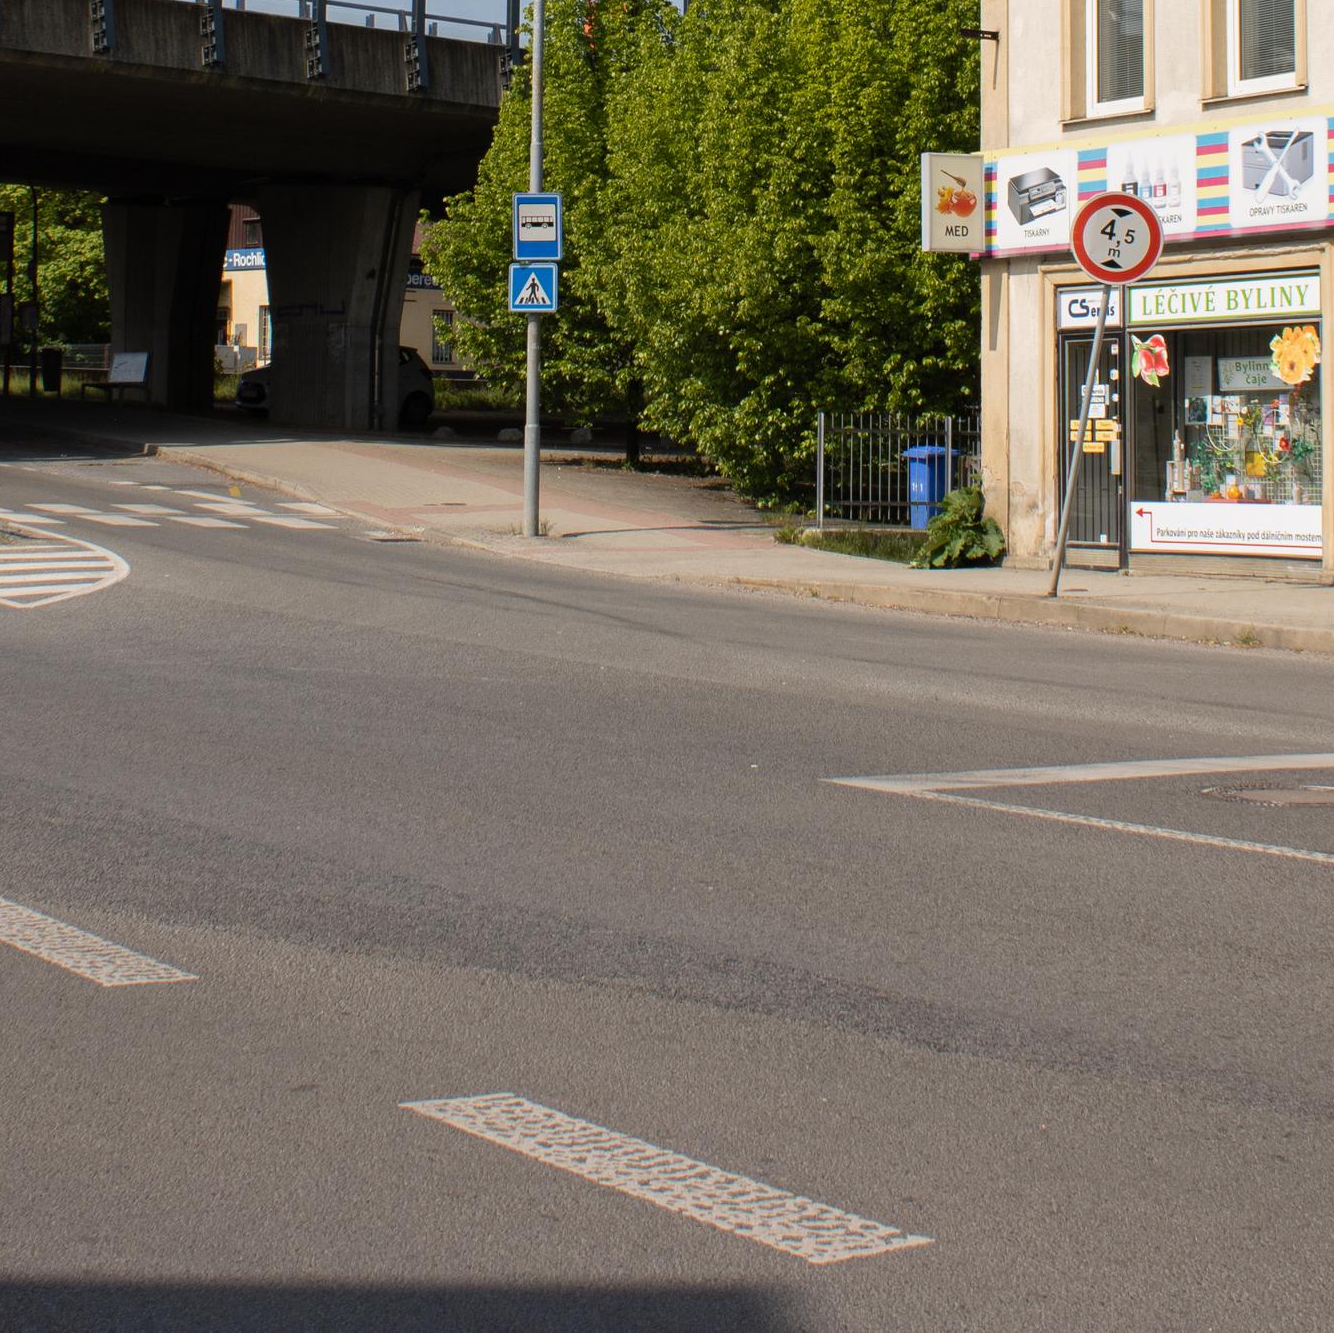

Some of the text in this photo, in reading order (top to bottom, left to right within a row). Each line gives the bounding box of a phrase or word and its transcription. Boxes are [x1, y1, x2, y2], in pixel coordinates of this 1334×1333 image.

[1249, 205, 1275, 217] OPRAVY
[945, 225, 969, 237] MED
[1100, 219, 1136, 245] 4,5
[1108, 247, 1121, 258] m
[1141, 283, 1309, 316] LÉČIVÉ BYLINY
[1235, 360, 1271, 374] Bylinn
[1245, 373, 1267, 386] čaje
[1156, 527, 1186, 537] Parkování
[1187, 530, 1198, 540] pro
[1199, 529, 1214, 539] naše
[1215, 529, 1245, 541] zákazníky
[1247, 530, 1260, 541] pod
[1294, 532, 1323, 542] mostem
